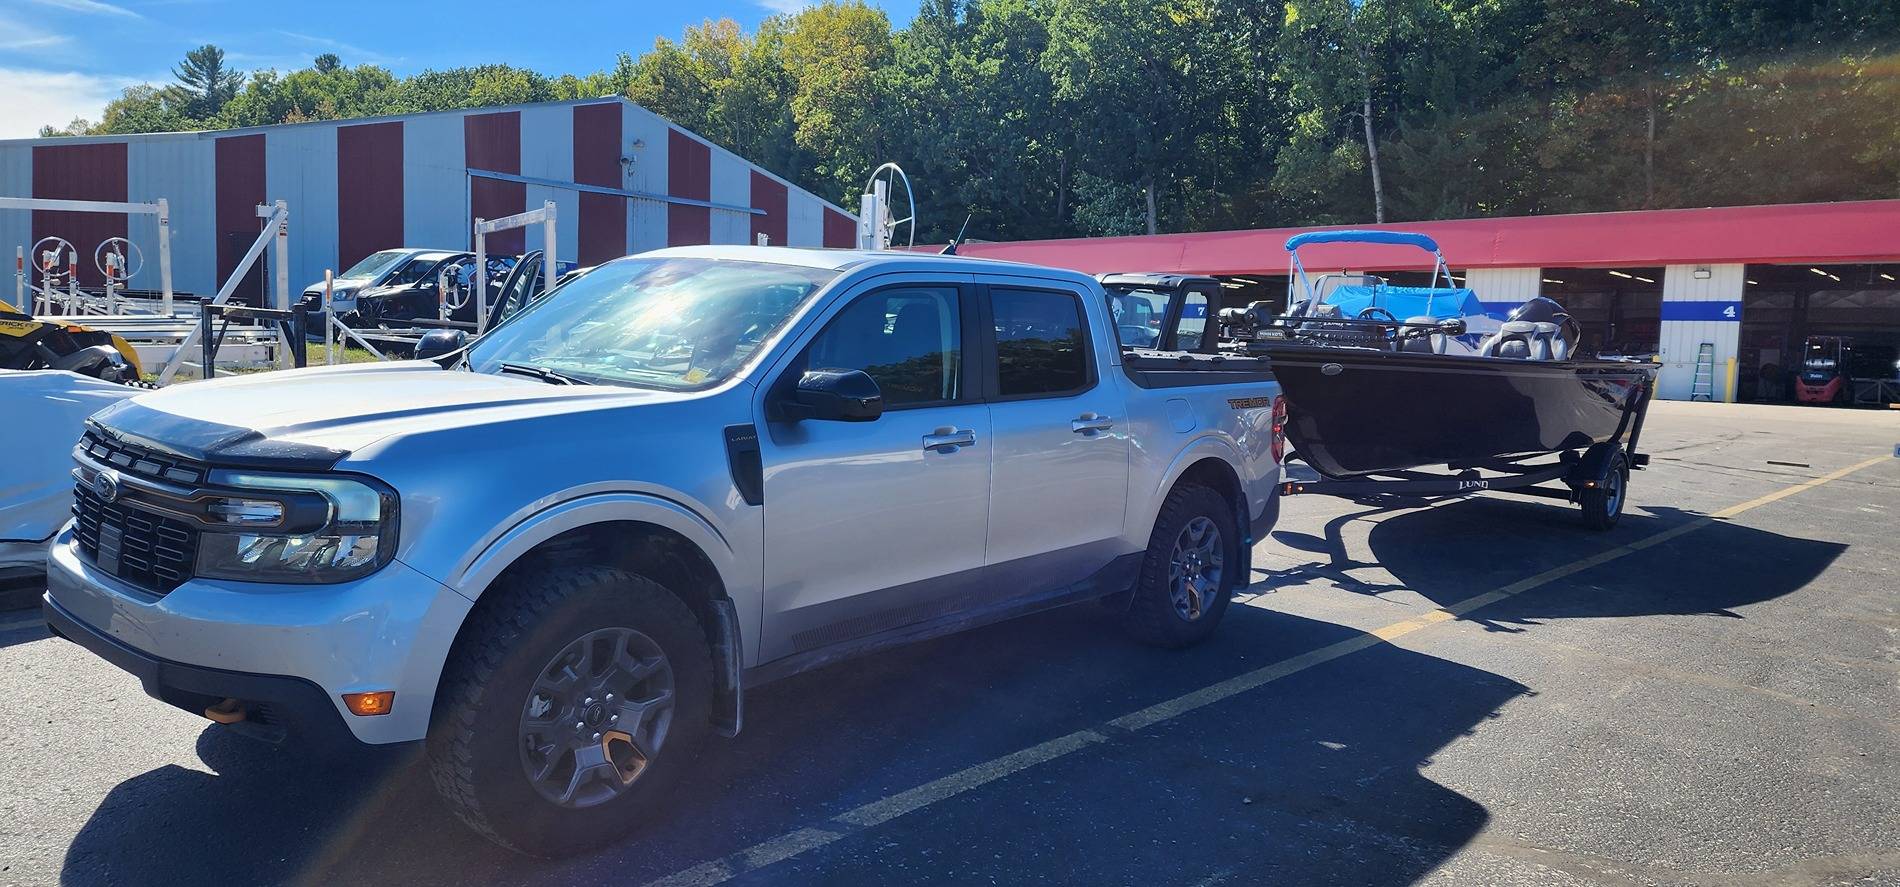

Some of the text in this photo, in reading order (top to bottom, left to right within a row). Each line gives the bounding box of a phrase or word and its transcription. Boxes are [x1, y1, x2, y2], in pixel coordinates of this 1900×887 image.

[1198, 307, 1206, 316] 7
[1723, 306, 1736, 317] 4
[1227, 397, 1270, 409] TREMOR
[1457, 480, 1489, 491] LUND
